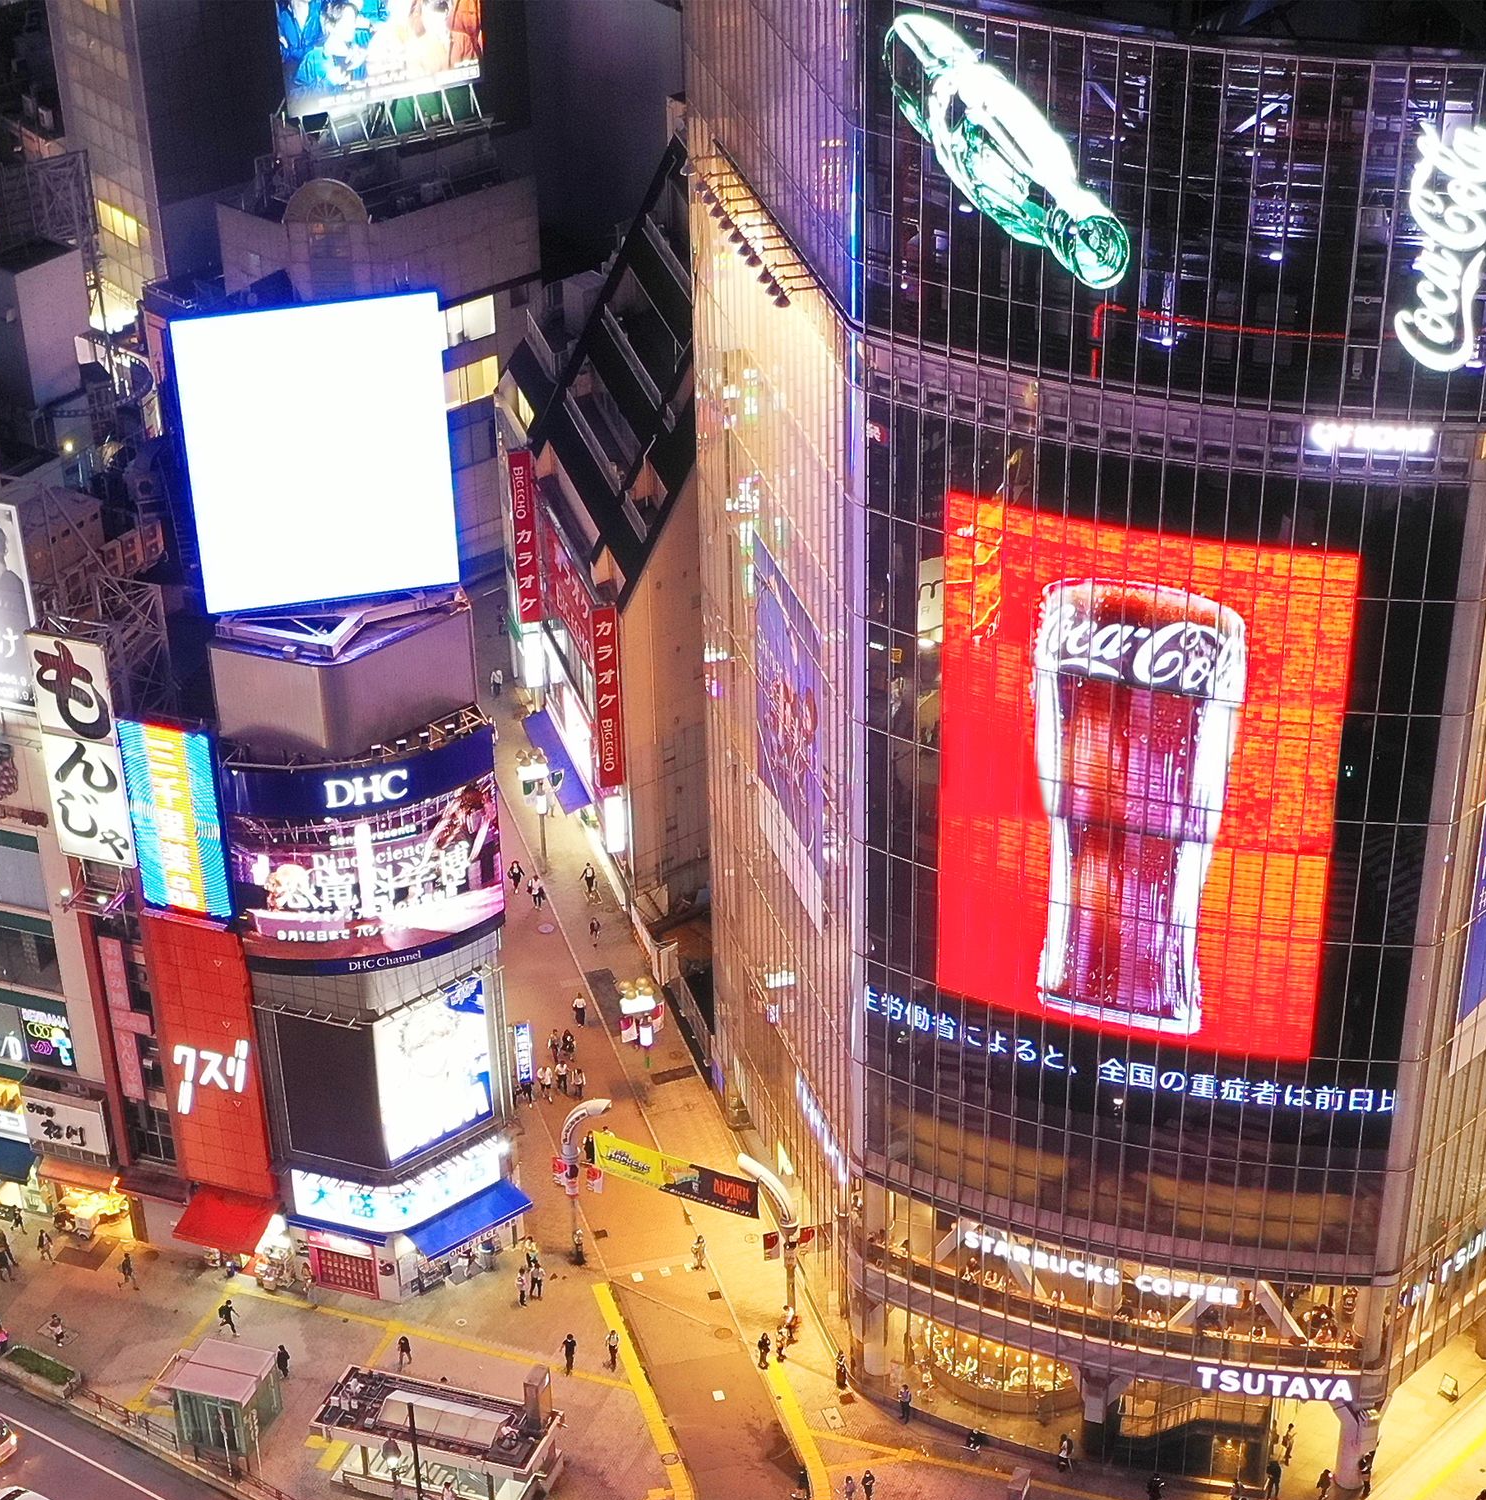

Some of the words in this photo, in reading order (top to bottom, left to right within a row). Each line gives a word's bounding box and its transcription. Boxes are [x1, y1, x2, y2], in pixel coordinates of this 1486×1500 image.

[516, 529, 534, 613] カラオケ
[596, 620, 617, 709] カラオケ
[34, 640, 130, 860] もんじゃ
[324, 769, 409, 810] DHC
[349, 958, 375, 972] DHC
[376, 950, 422, 969] Channel
[174, 1040, 249, 1115] クスリ
[964, 1230, 1121, 1287] STARBUCKS
[1134, 1273, 1240, 1306] COFFEE
[1197, 1365, 1354, 1402] TSUTAYA
